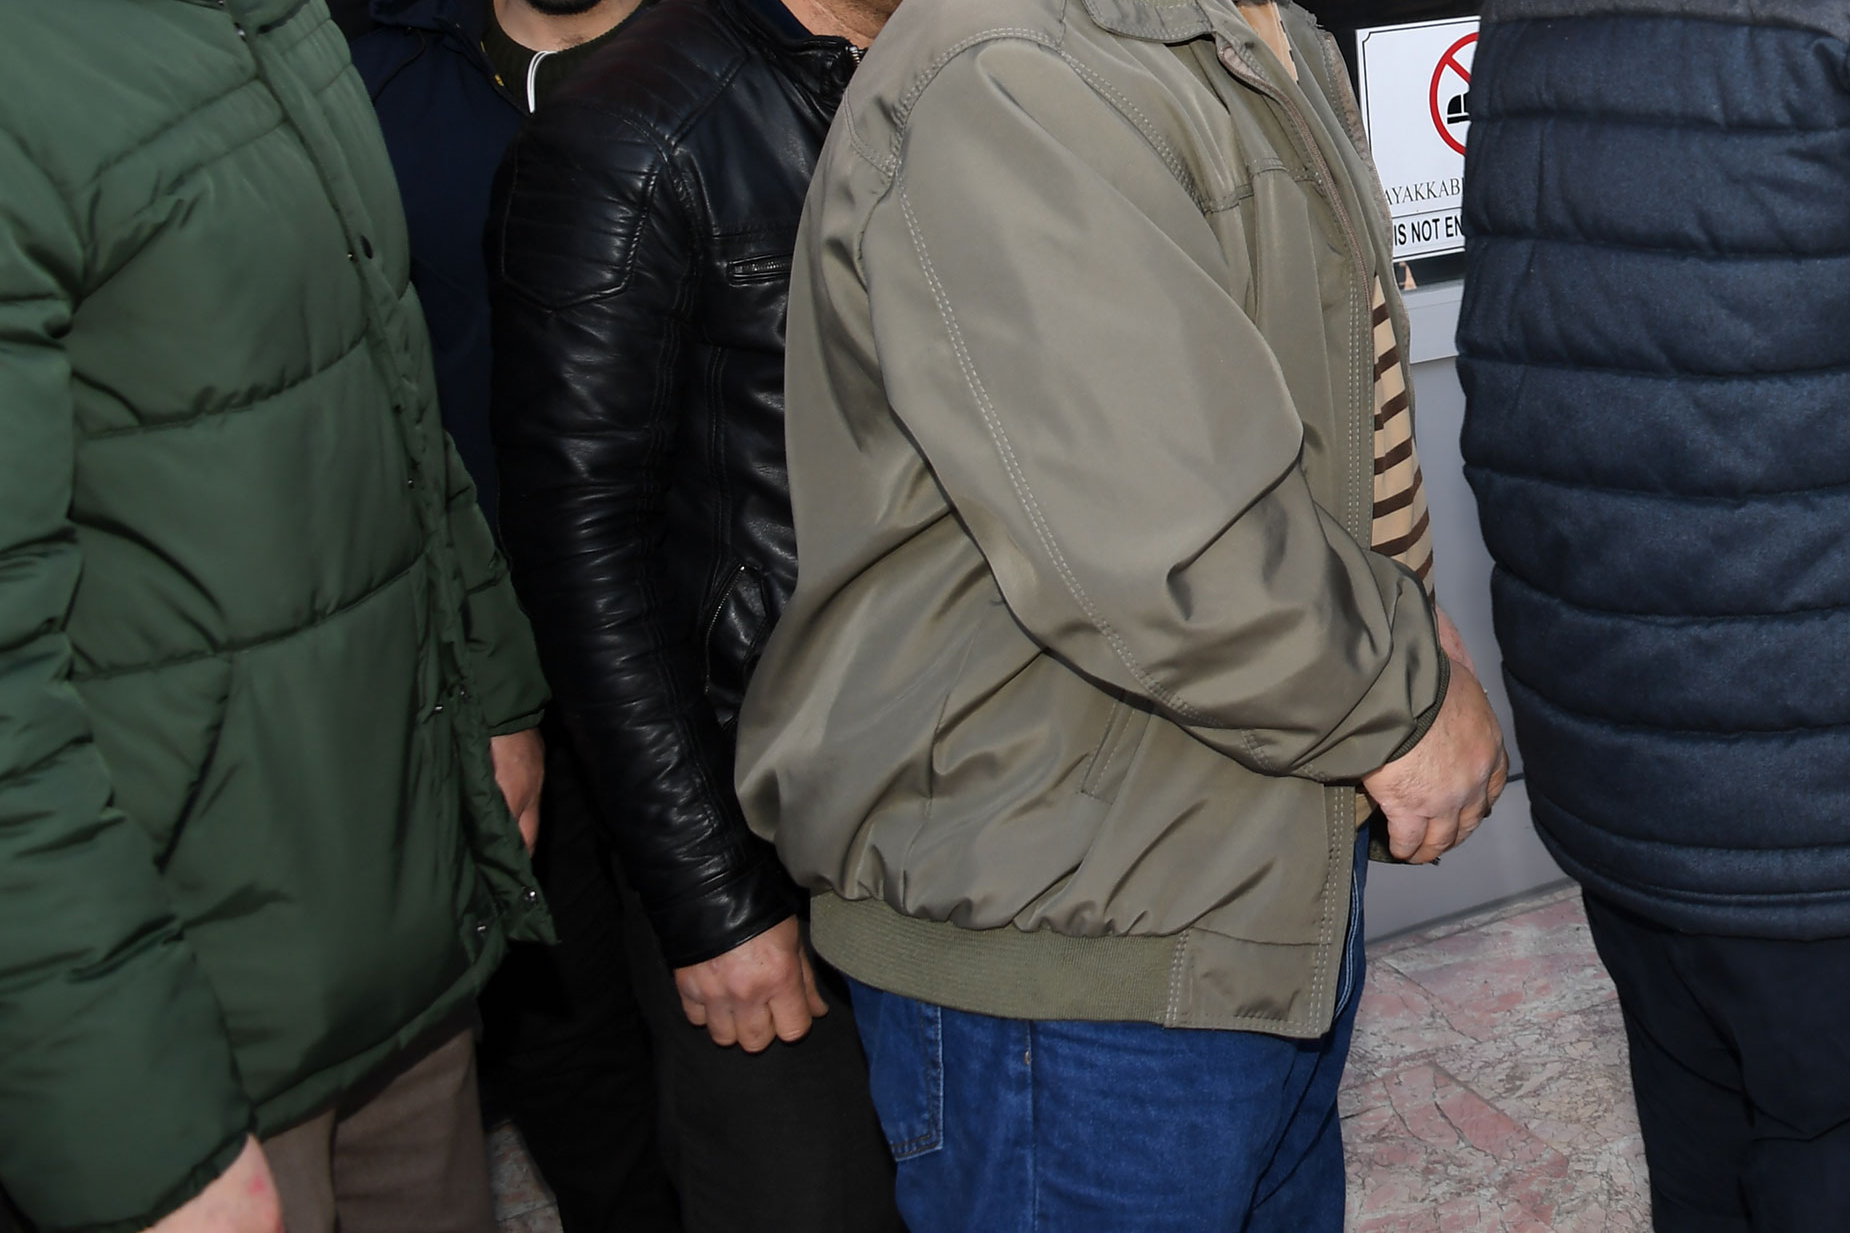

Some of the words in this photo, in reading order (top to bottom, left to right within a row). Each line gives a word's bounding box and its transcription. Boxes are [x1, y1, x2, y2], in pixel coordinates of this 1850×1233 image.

[1385, 177, 1464, 205] AYAKKAB
[1394, 223, 1407, 246] IS
[1411, 218, 1440, 243] NOT
